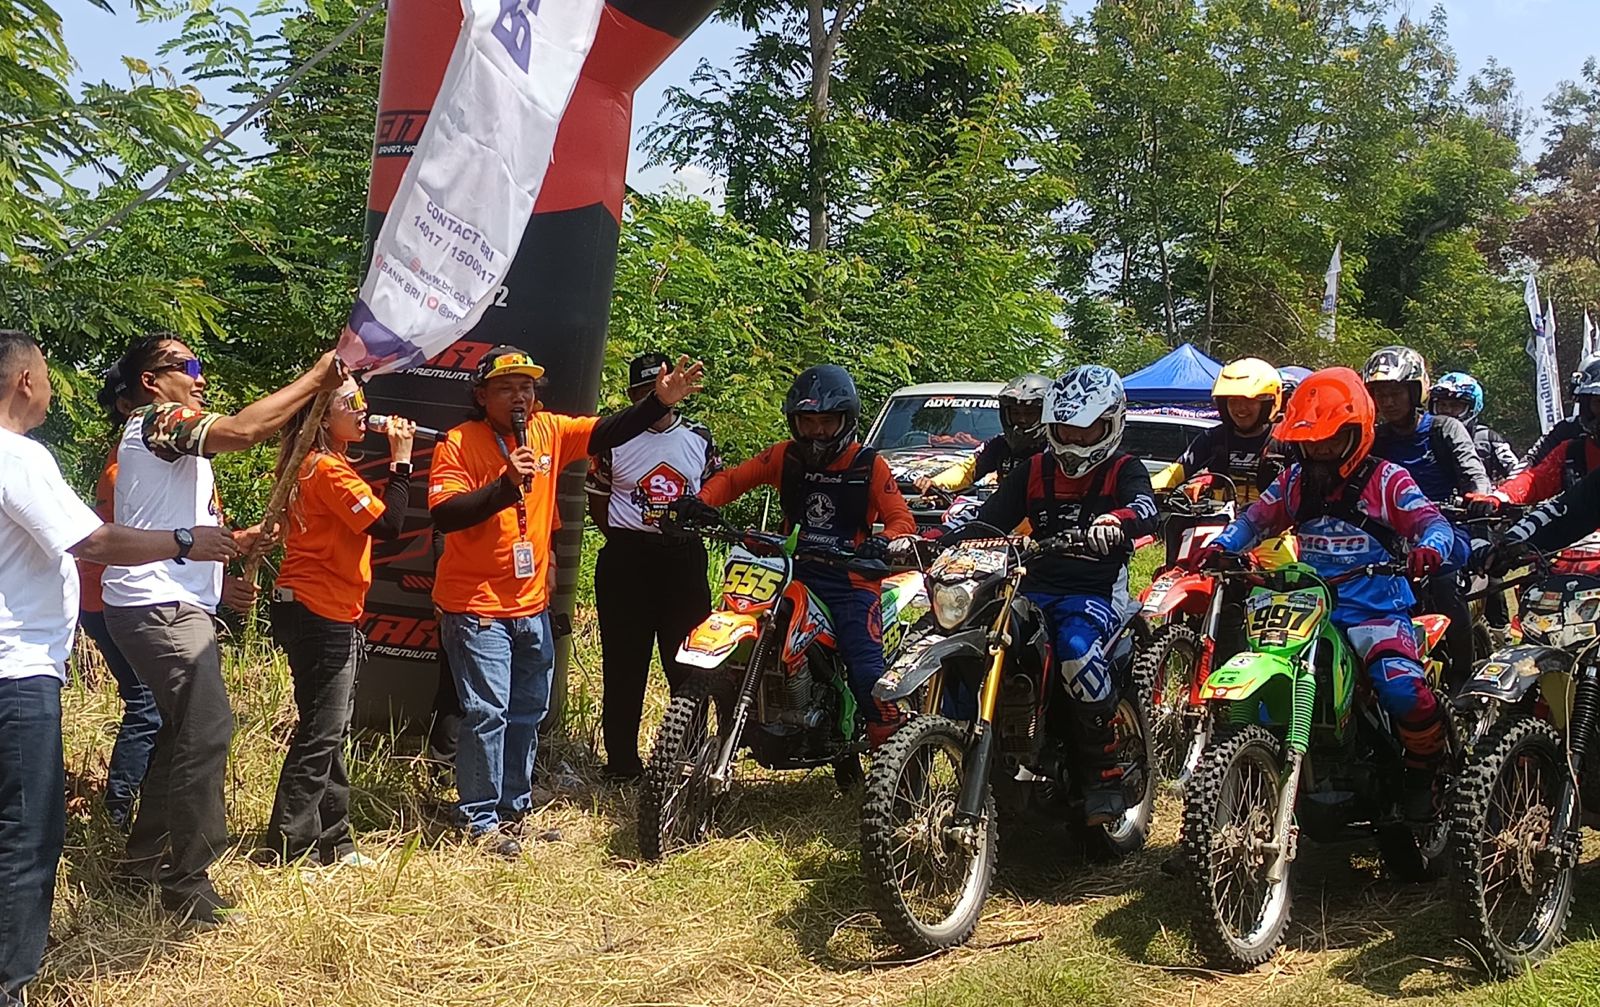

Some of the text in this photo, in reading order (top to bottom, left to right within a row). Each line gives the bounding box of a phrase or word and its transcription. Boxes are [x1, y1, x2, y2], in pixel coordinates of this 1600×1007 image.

[413, 215, 443, 247] 14017
[426, 201, 495, 262] CONTACT BRI
[380, 262, 405, 288] BANK
[403, 283, 421, 300] BRI
[420, 267, 476, 309] www.bri.co.id
[406, 367, 470, 381] PREMIUM
[923, 398, 1000, 409] ADVENTUR
[959, 538, 1022, 549] RENTHAL
[722, 563, 784, 601] 555
[1251, 604, 1314, 631] 997
[373, 645, 438, 661] PREMIUM
